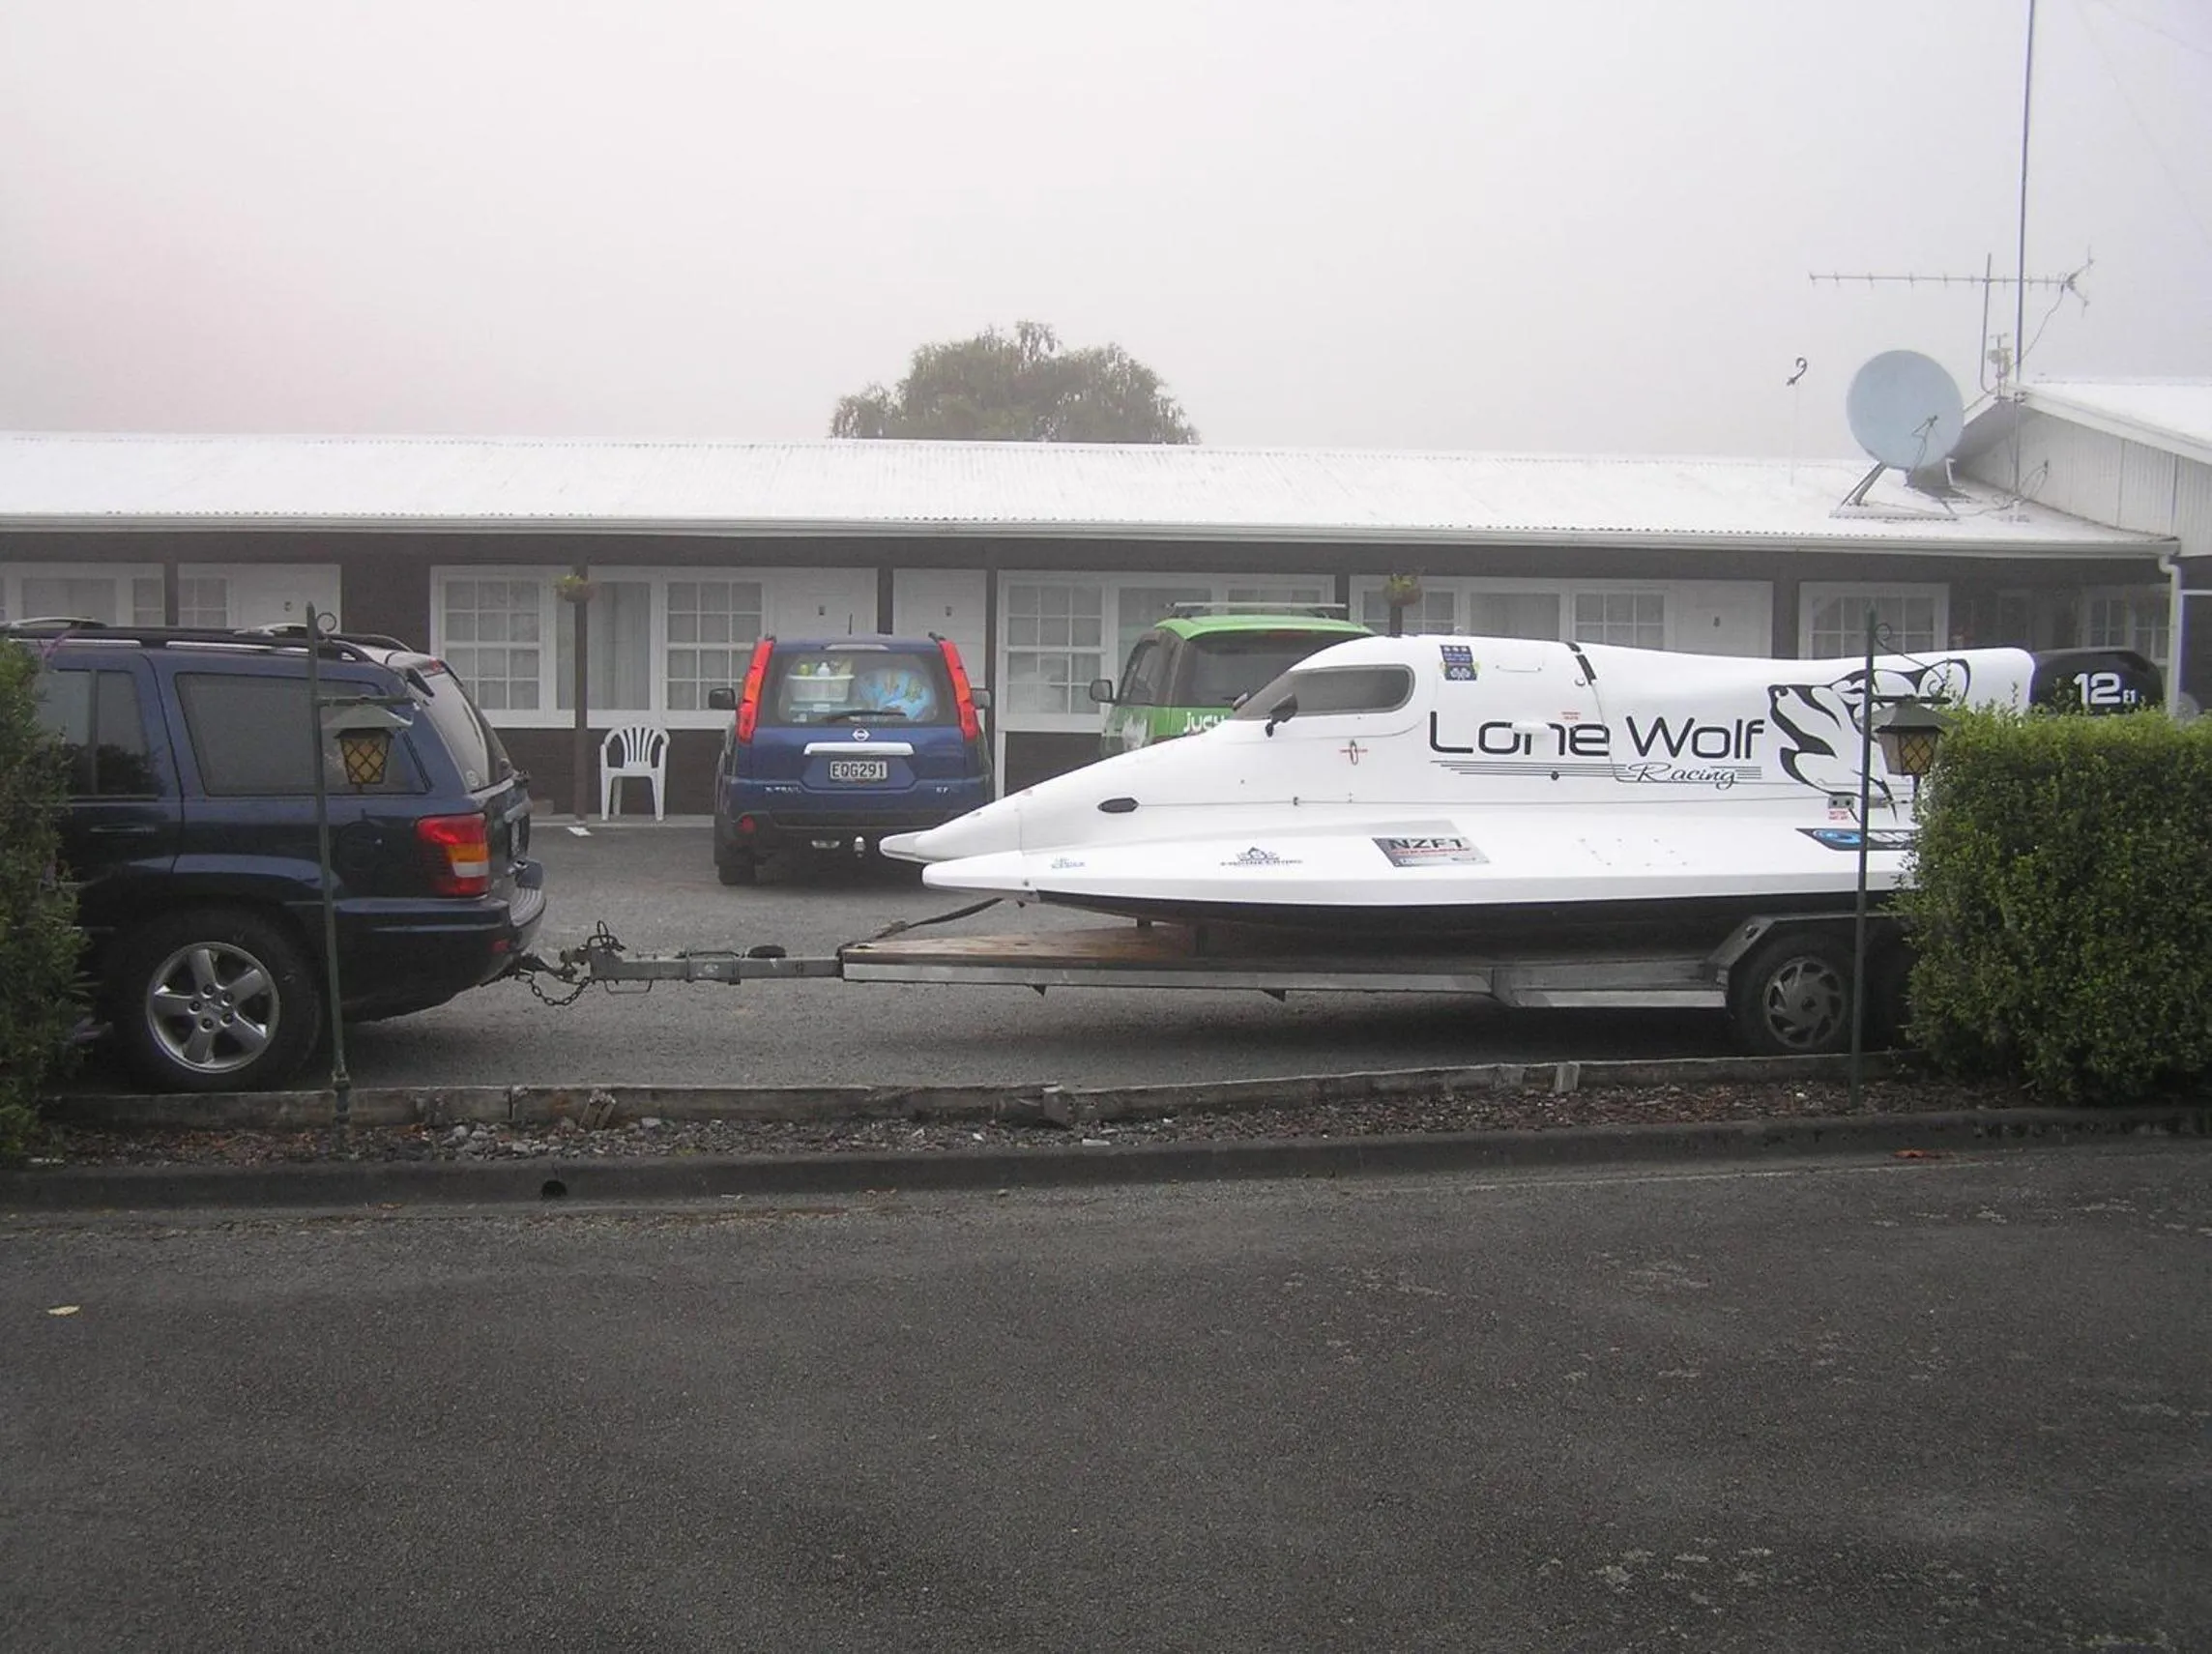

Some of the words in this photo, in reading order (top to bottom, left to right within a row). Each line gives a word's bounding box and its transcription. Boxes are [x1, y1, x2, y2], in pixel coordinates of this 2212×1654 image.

[2073, 672, 2121, 705] 12
[1430, 711, 1611, 757] Lone
[1625, 715, 1765, 760] Wolf
[1627, 762, 1736, 791] Racing
